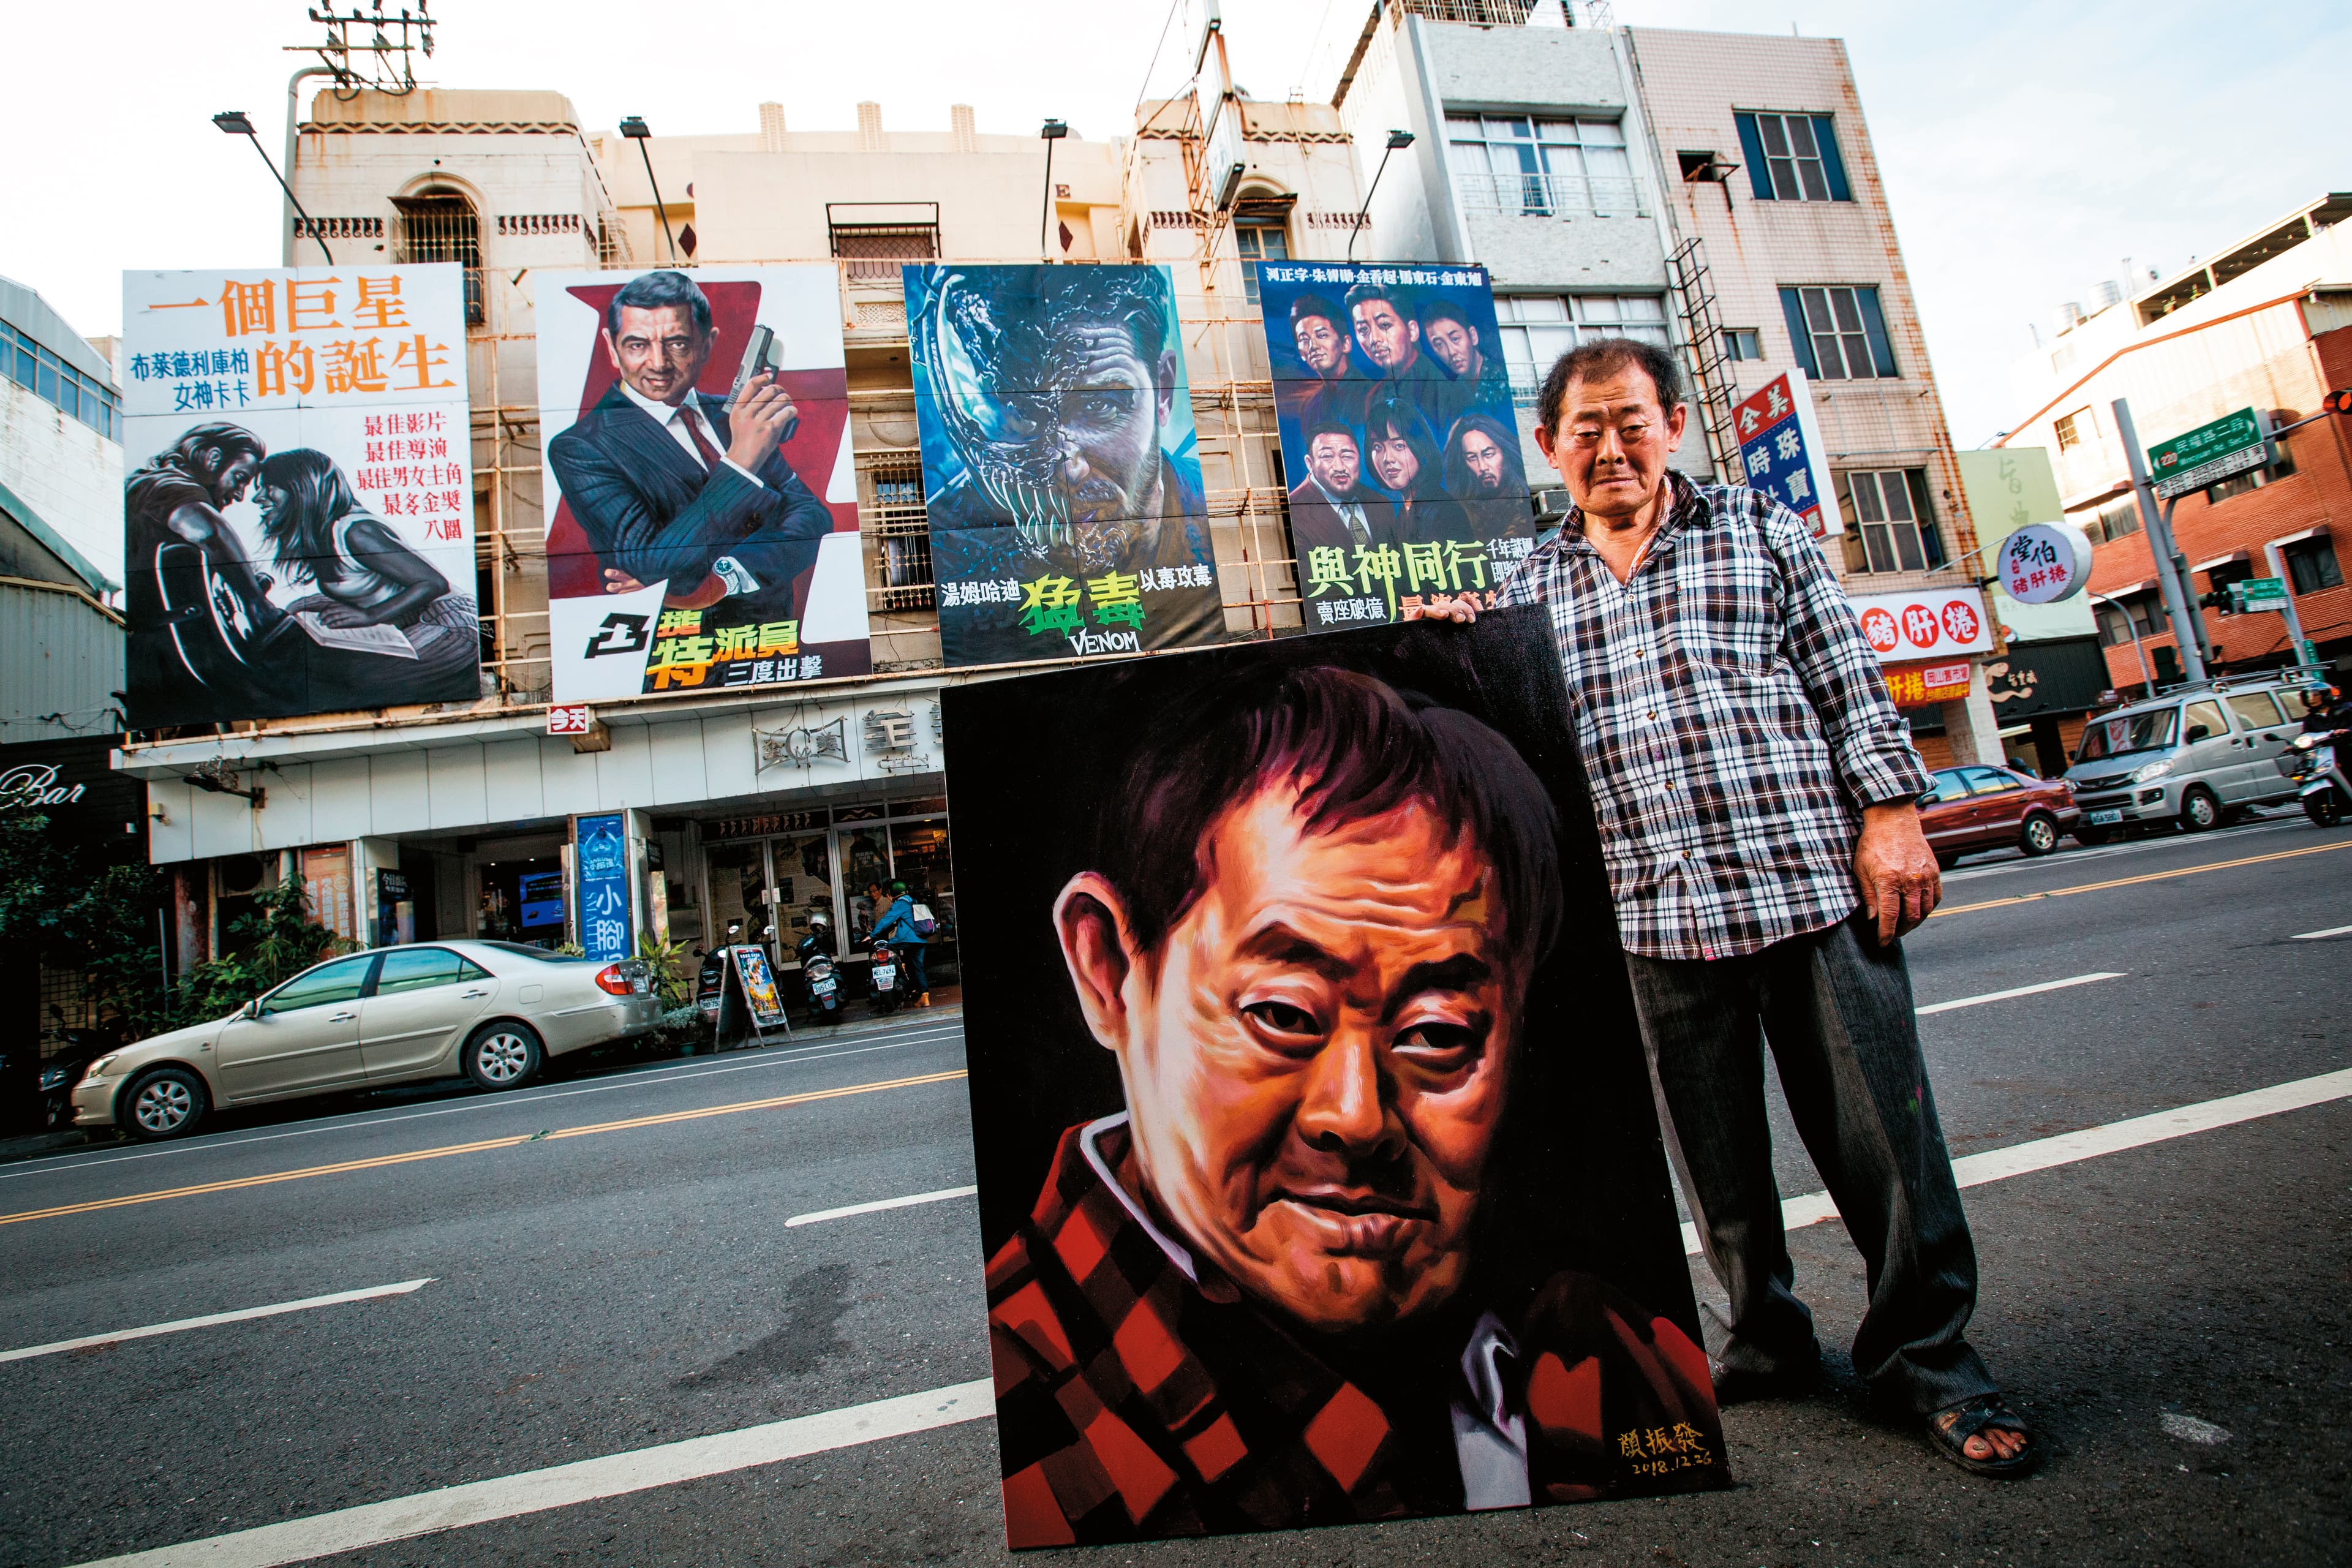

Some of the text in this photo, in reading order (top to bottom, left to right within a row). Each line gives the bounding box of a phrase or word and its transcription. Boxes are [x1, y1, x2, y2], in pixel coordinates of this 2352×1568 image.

[149, 274, 411, 337] 一個巨星
[130, 348, 249, 382] 布萊德利庫柏
[255, 334, 458, 397] 的誕生
[173, 379, 250, 412] 女神卡卡
[1739, 385, 1789, 435] 全美
[364, 411, 447, 437] 最佳影片
[2176, 417, 2246, 454] 民權路二段
[364, 437, 447, 463] 最佳導演
[1775, 428, 1811, 504] 珠寶
[356, 462, 462, 491] 最佳男女主角
[382, 489, 461, 516] 最多金獎
[2010, 535, 2057, 567] 堂伯
[1140, 564, 1212, 592] 以毒攻毒
[1308, 540, 1488, 624] 與神同行
[1491, 560, 1519, 583] 即將
[2012, 564, 2068, 595] 豬肝捲
[941, 577, 1022, 607] 湯姆哈迪
[1018, 570, 1147, 639] 猛毒
[1316, 596, 1386, 625] 賣座破億
[1865, 603, 1978, 649] 豬肝捲
[1068, 627, 1142, 656] VENOM
[725, 655, 822, 687] 三度出擊
[550, 706, 586, 731] 今天
[0, 764, 86, 809] Bar
[814, 981, 835, 993] 395-LUN
